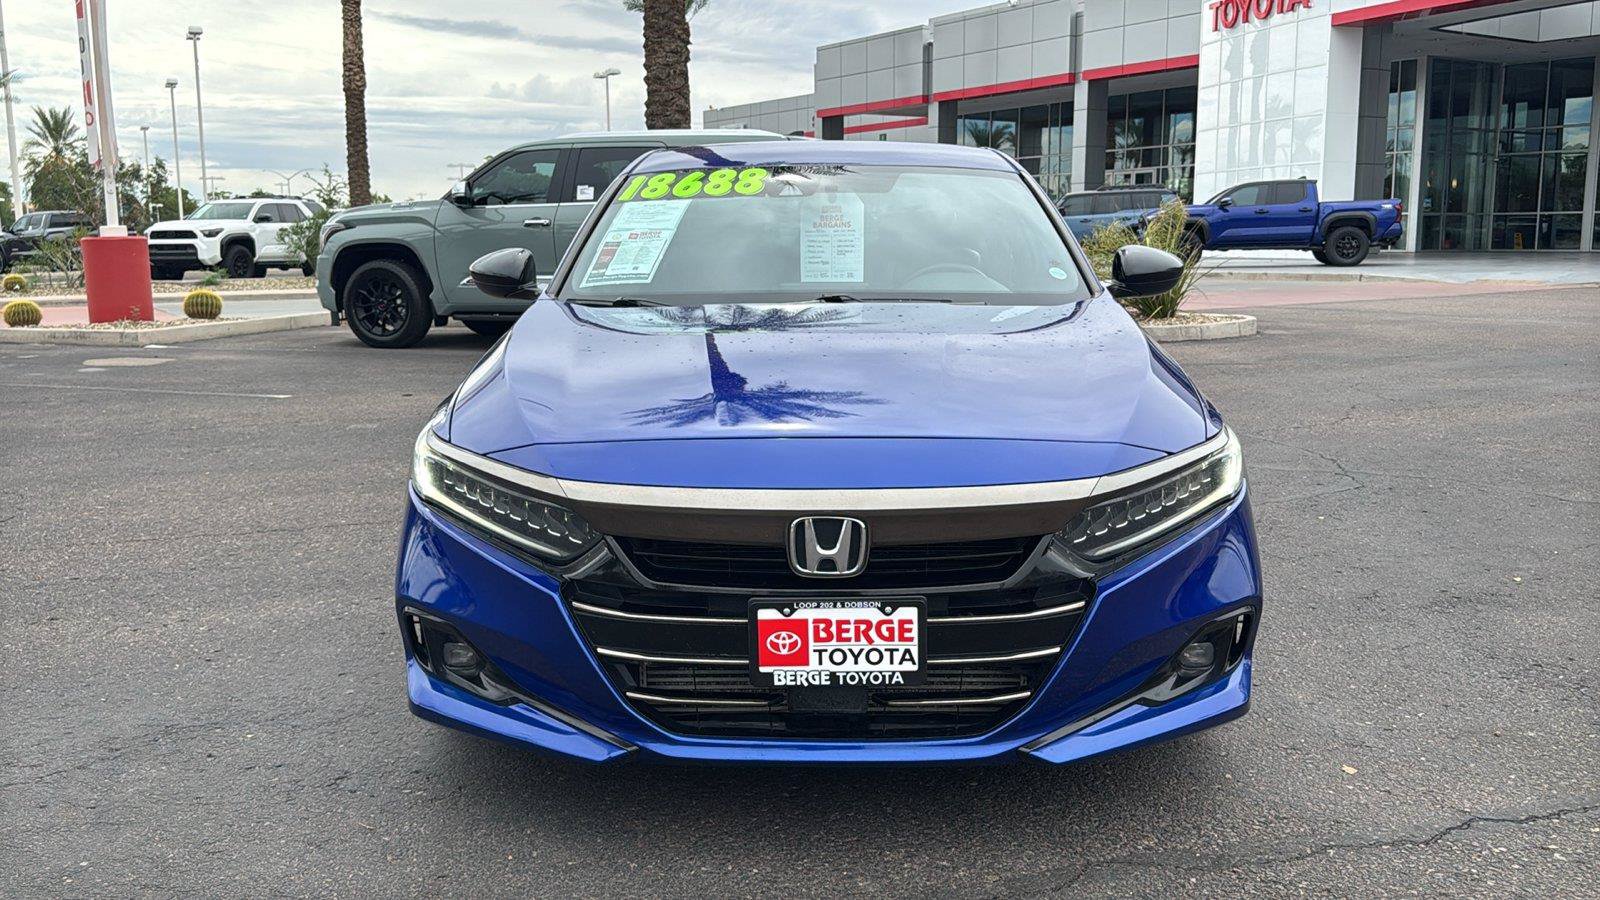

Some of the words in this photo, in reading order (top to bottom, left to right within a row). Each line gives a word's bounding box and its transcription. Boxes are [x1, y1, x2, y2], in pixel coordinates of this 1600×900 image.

[618, 168, 768, 201] 18688
[813, 221, 852, 229] BARGAINS
[812, 618, 915, 645] BERGE
[813, 648, 917, 666] TOYOTA
[773, 670, 831, 687] BERGE
[836, 671, 904, 685] TOYOTA
